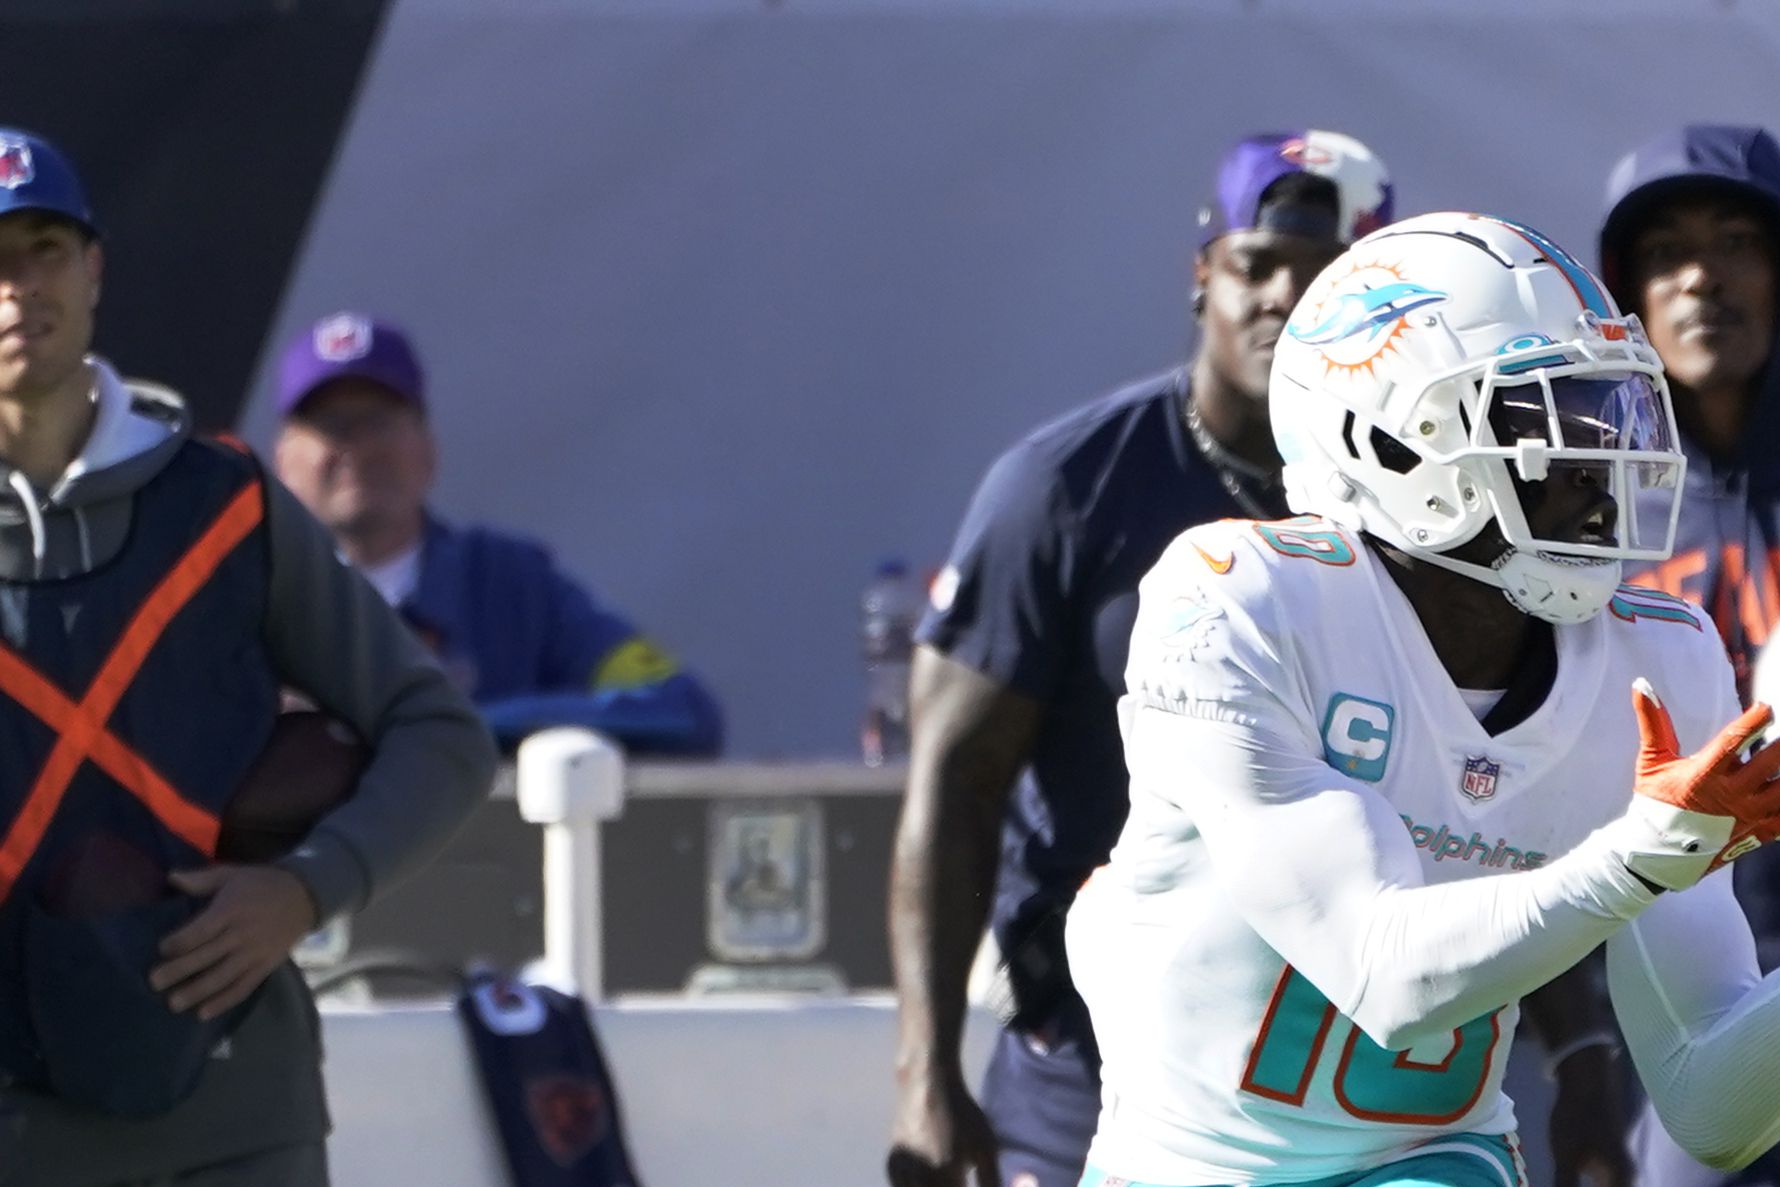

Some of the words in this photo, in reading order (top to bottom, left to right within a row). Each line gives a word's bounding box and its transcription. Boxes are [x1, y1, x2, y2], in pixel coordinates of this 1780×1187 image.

[1327, 699, 1390, 761] C
[1464, 771, 1495, 795] NFL
[1400, 813, 1549, 871] olphins
